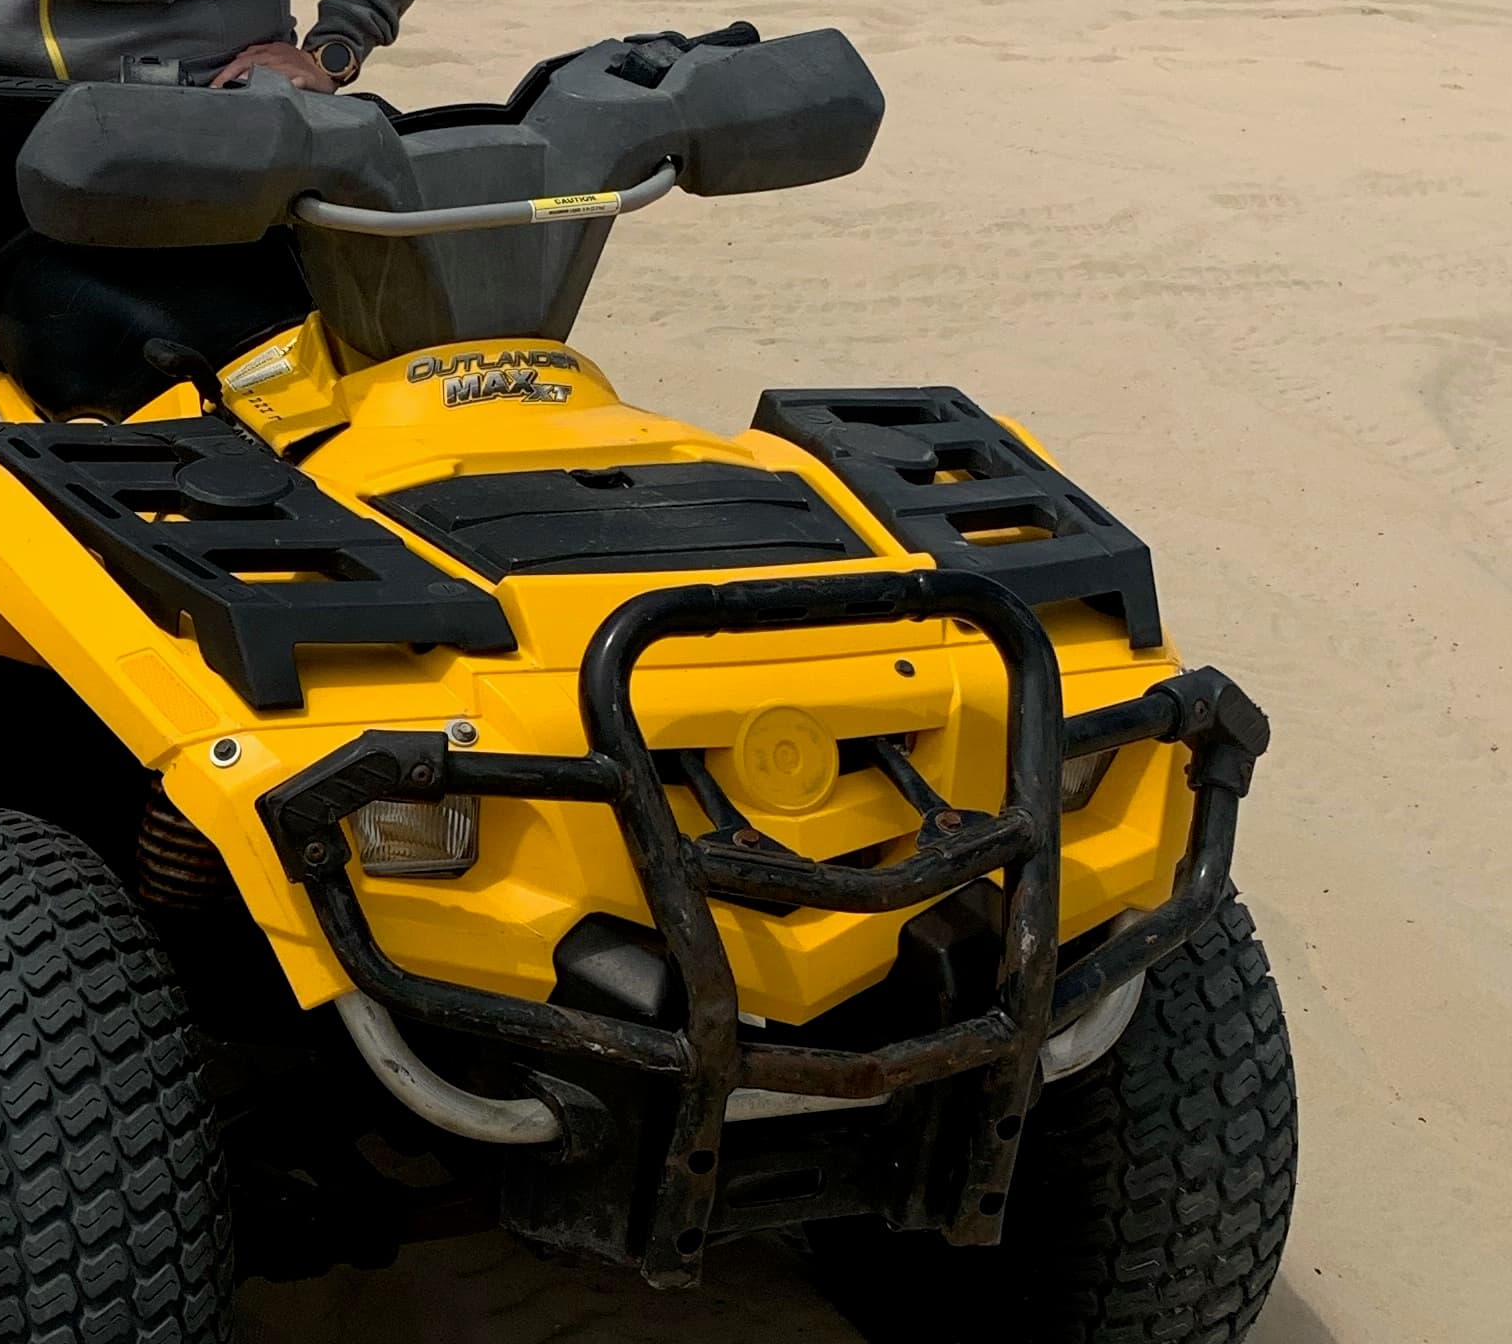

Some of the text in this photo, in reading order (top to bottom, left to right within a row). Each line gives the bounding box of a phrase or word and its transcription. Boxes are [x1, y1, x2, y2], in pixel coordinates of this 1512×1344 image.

[553, 195, 597, 205] CAUTION
[407, 351, 581, 384] OUTLANDER
[445, 368, 573, 406] MAX XT
